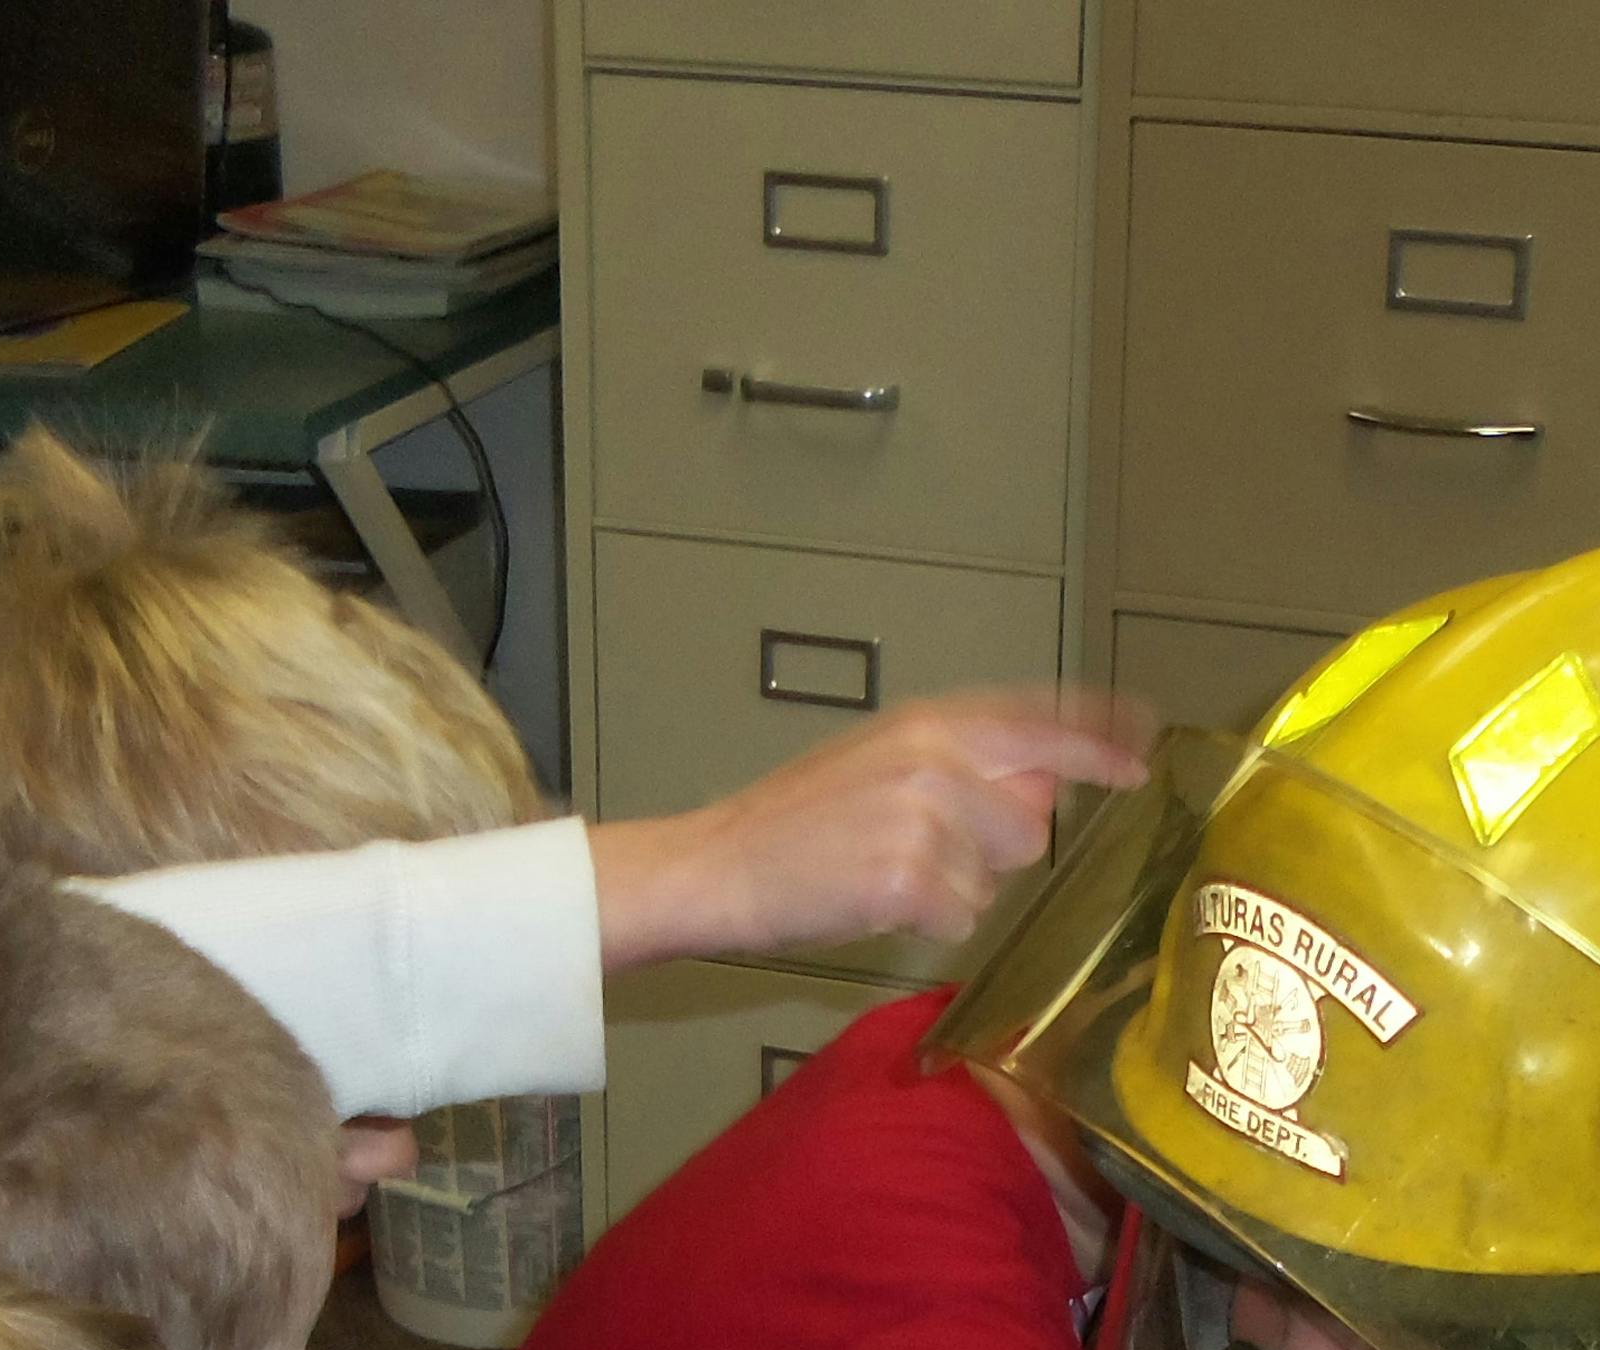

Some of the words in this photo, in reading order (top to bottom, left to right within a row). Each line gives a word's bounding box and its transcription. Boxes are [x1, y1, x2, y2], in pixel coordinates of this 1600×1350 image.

[1293, 928, 1393, 1032] RURAL
[1201, 1082, 1241, 1125] FIRE
[1247, 1110, 1307, 1158] DEPT.
